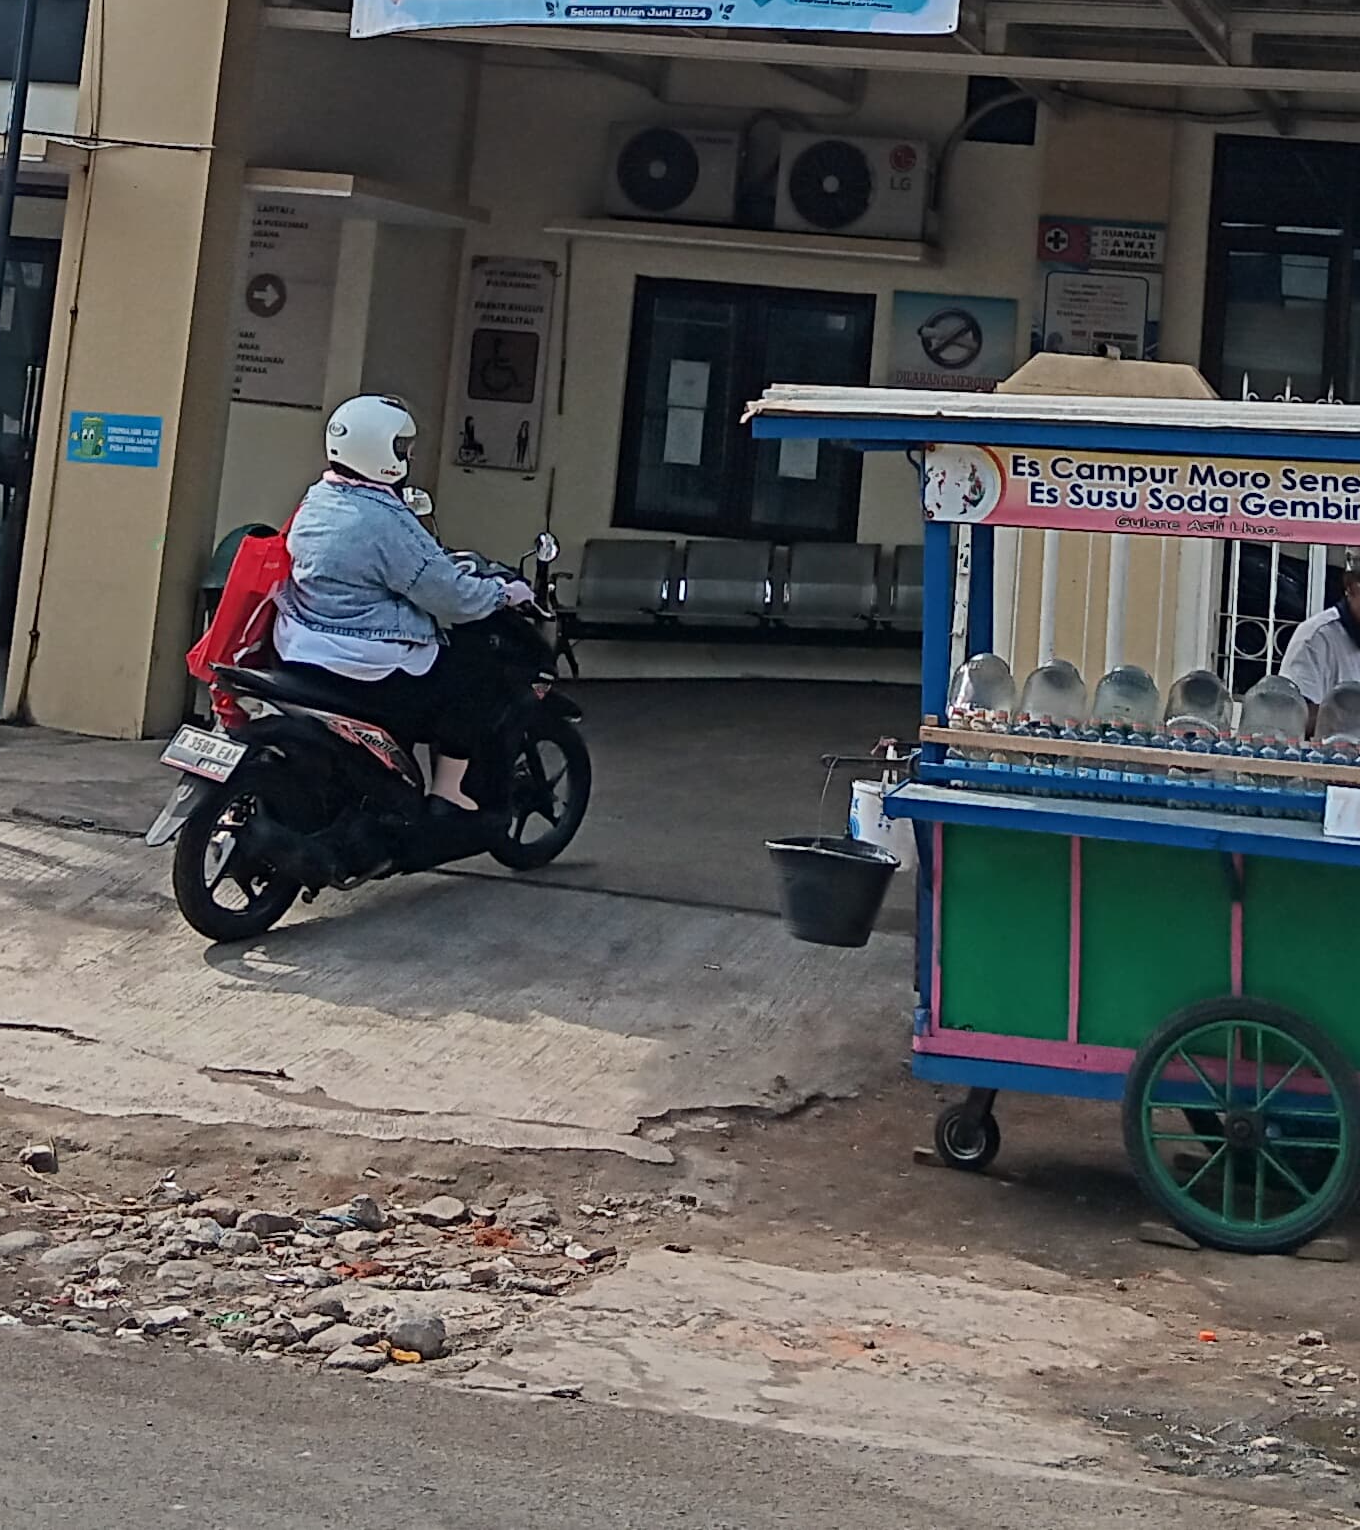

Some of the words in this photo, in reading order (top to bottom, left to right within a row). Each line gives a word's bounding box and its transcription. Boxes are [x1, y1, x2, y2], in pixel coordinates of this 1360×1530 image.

[570, 7, 610, 18] Selama
[613, 7, 645, 19] Bulan
[647, 7, 672, 19] Juni
[675, 8, 706, 19] 2024
[889, 176, 912, 190] LG
[1101, 229, 1156, 241] RUANGAN
[1011, 455, 1041, 478] Es
[1051, 458, 1180, 491] Campur
[1188, 464, 1270, 490] Moro
[1030, 482, 1059, 507] Es
[1069, 485, 1136, 511] Susu
[1148, 488, 1230, 516] Soda
[1187, 519, 1224, 532] Asli
